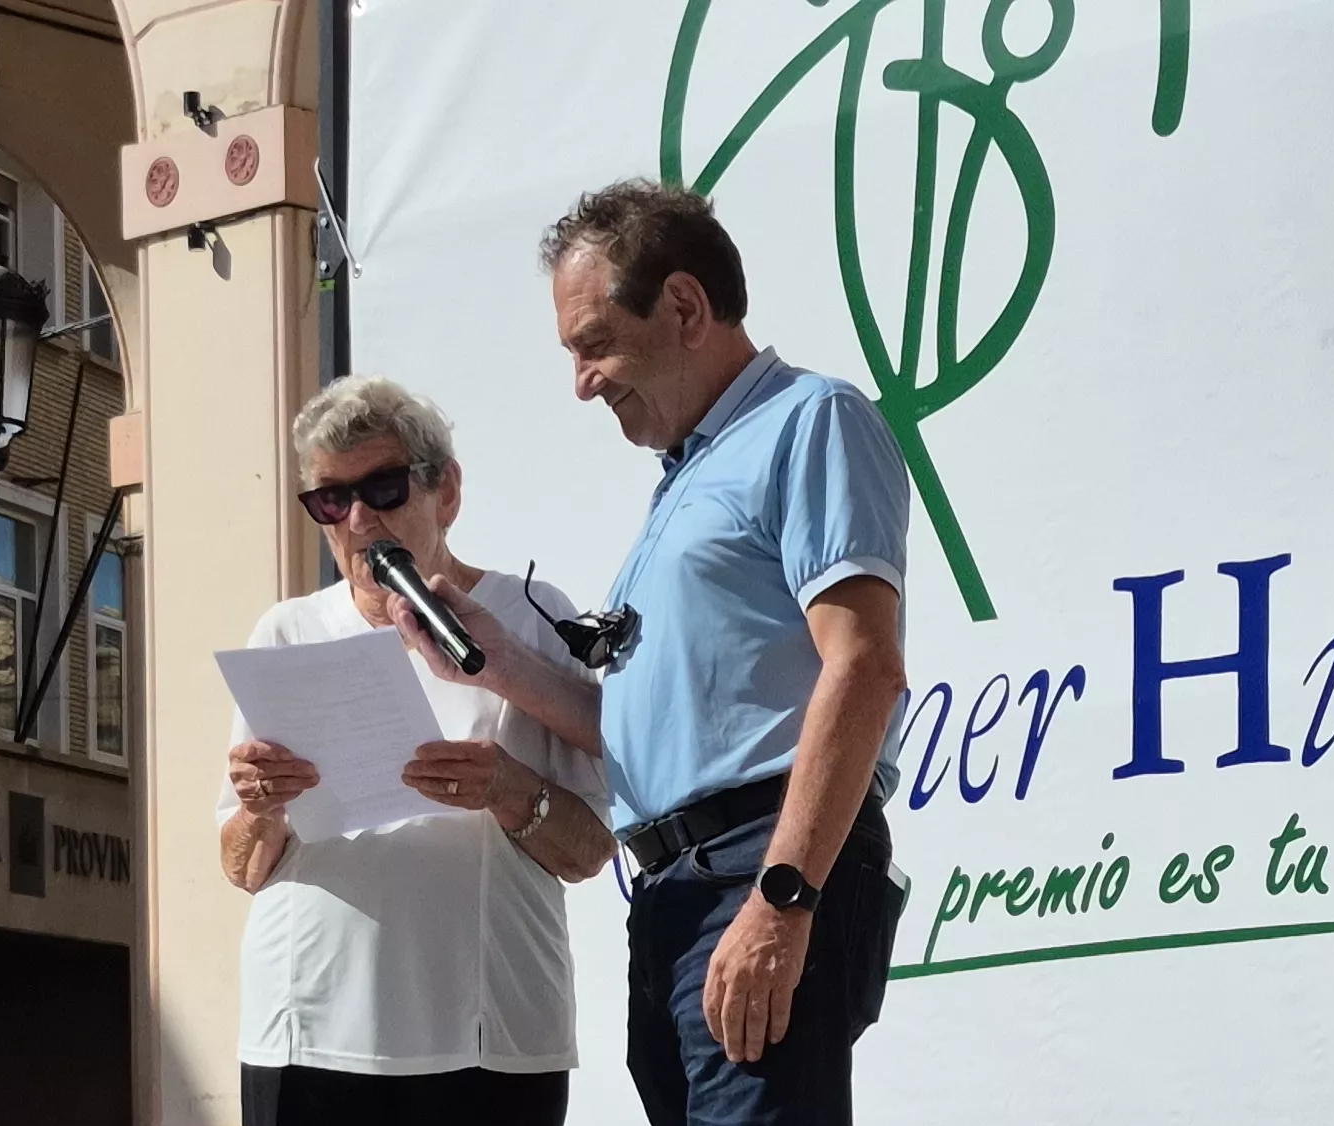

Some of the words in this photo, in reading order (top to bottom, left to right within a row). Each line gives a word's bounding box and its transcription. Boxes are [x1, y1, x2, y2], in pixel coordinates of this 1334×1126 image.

[924, 832, 1130, 967] premio
[1159, 845, 1235, 904] es
[1266, 813, 1329, 895] tu
